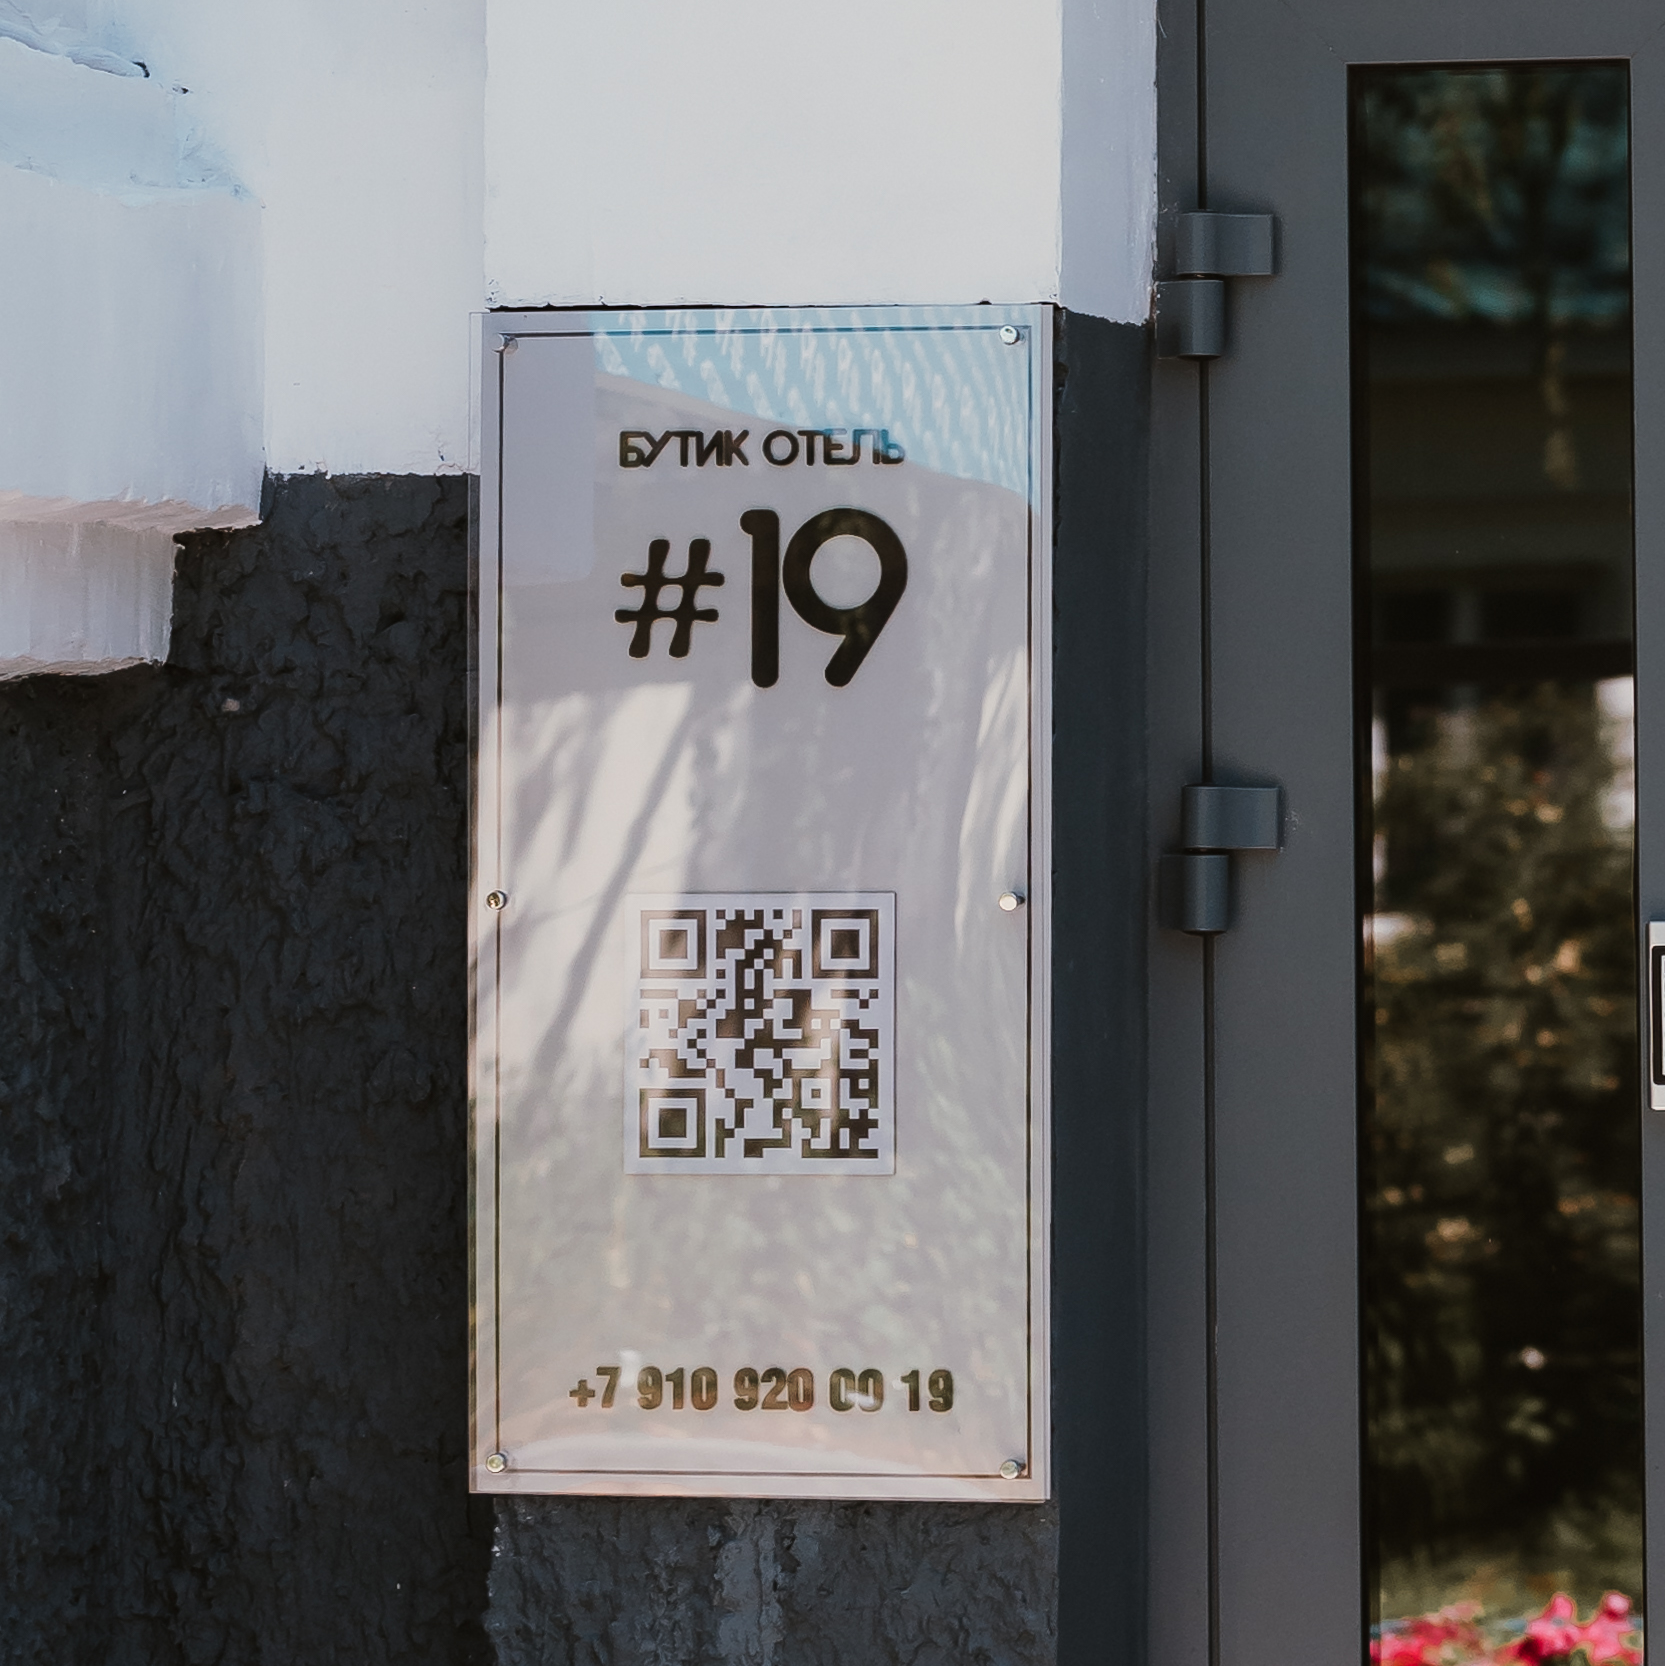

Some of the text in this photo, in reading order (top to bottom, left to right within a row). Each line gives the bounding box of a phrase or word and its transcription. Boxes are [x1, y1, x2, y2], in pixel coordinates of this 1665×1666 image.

[619, 428, 906, 468] БУТИК ОТЕЛЬ
[614, 506, 909, 688] #19
[569, 1366, 954, 1413] +7 910 920 00 19
